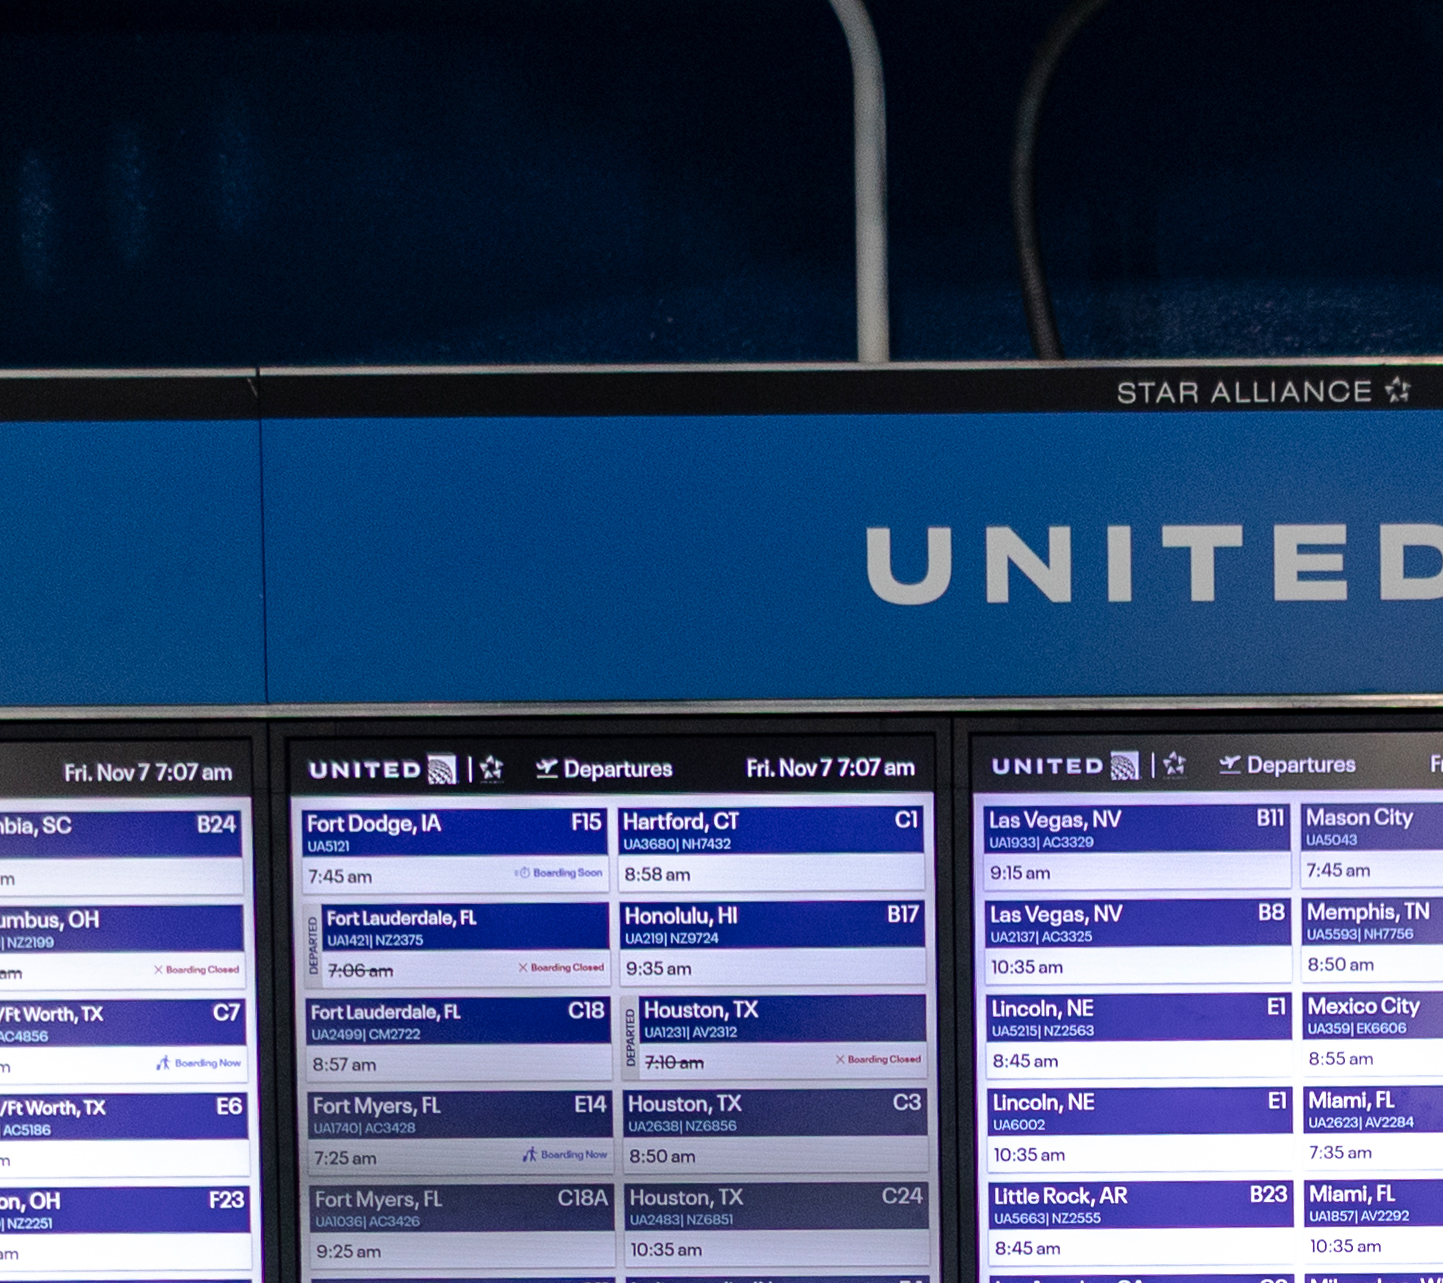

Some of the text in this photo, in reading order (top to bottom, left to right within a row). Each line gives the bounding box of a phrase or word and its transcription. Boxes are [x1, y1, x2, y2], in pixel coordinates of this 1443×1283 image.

[1118, 380, 1371, 404] STAR ALLIANCE
[65, 763, 232, 781] Fri. Nov 7 7:07 am
[43, 817, 71, 833] SC
[198, 816, 235, 832] B24
[626, 905, 919, 927] Honolulu, HI B17
